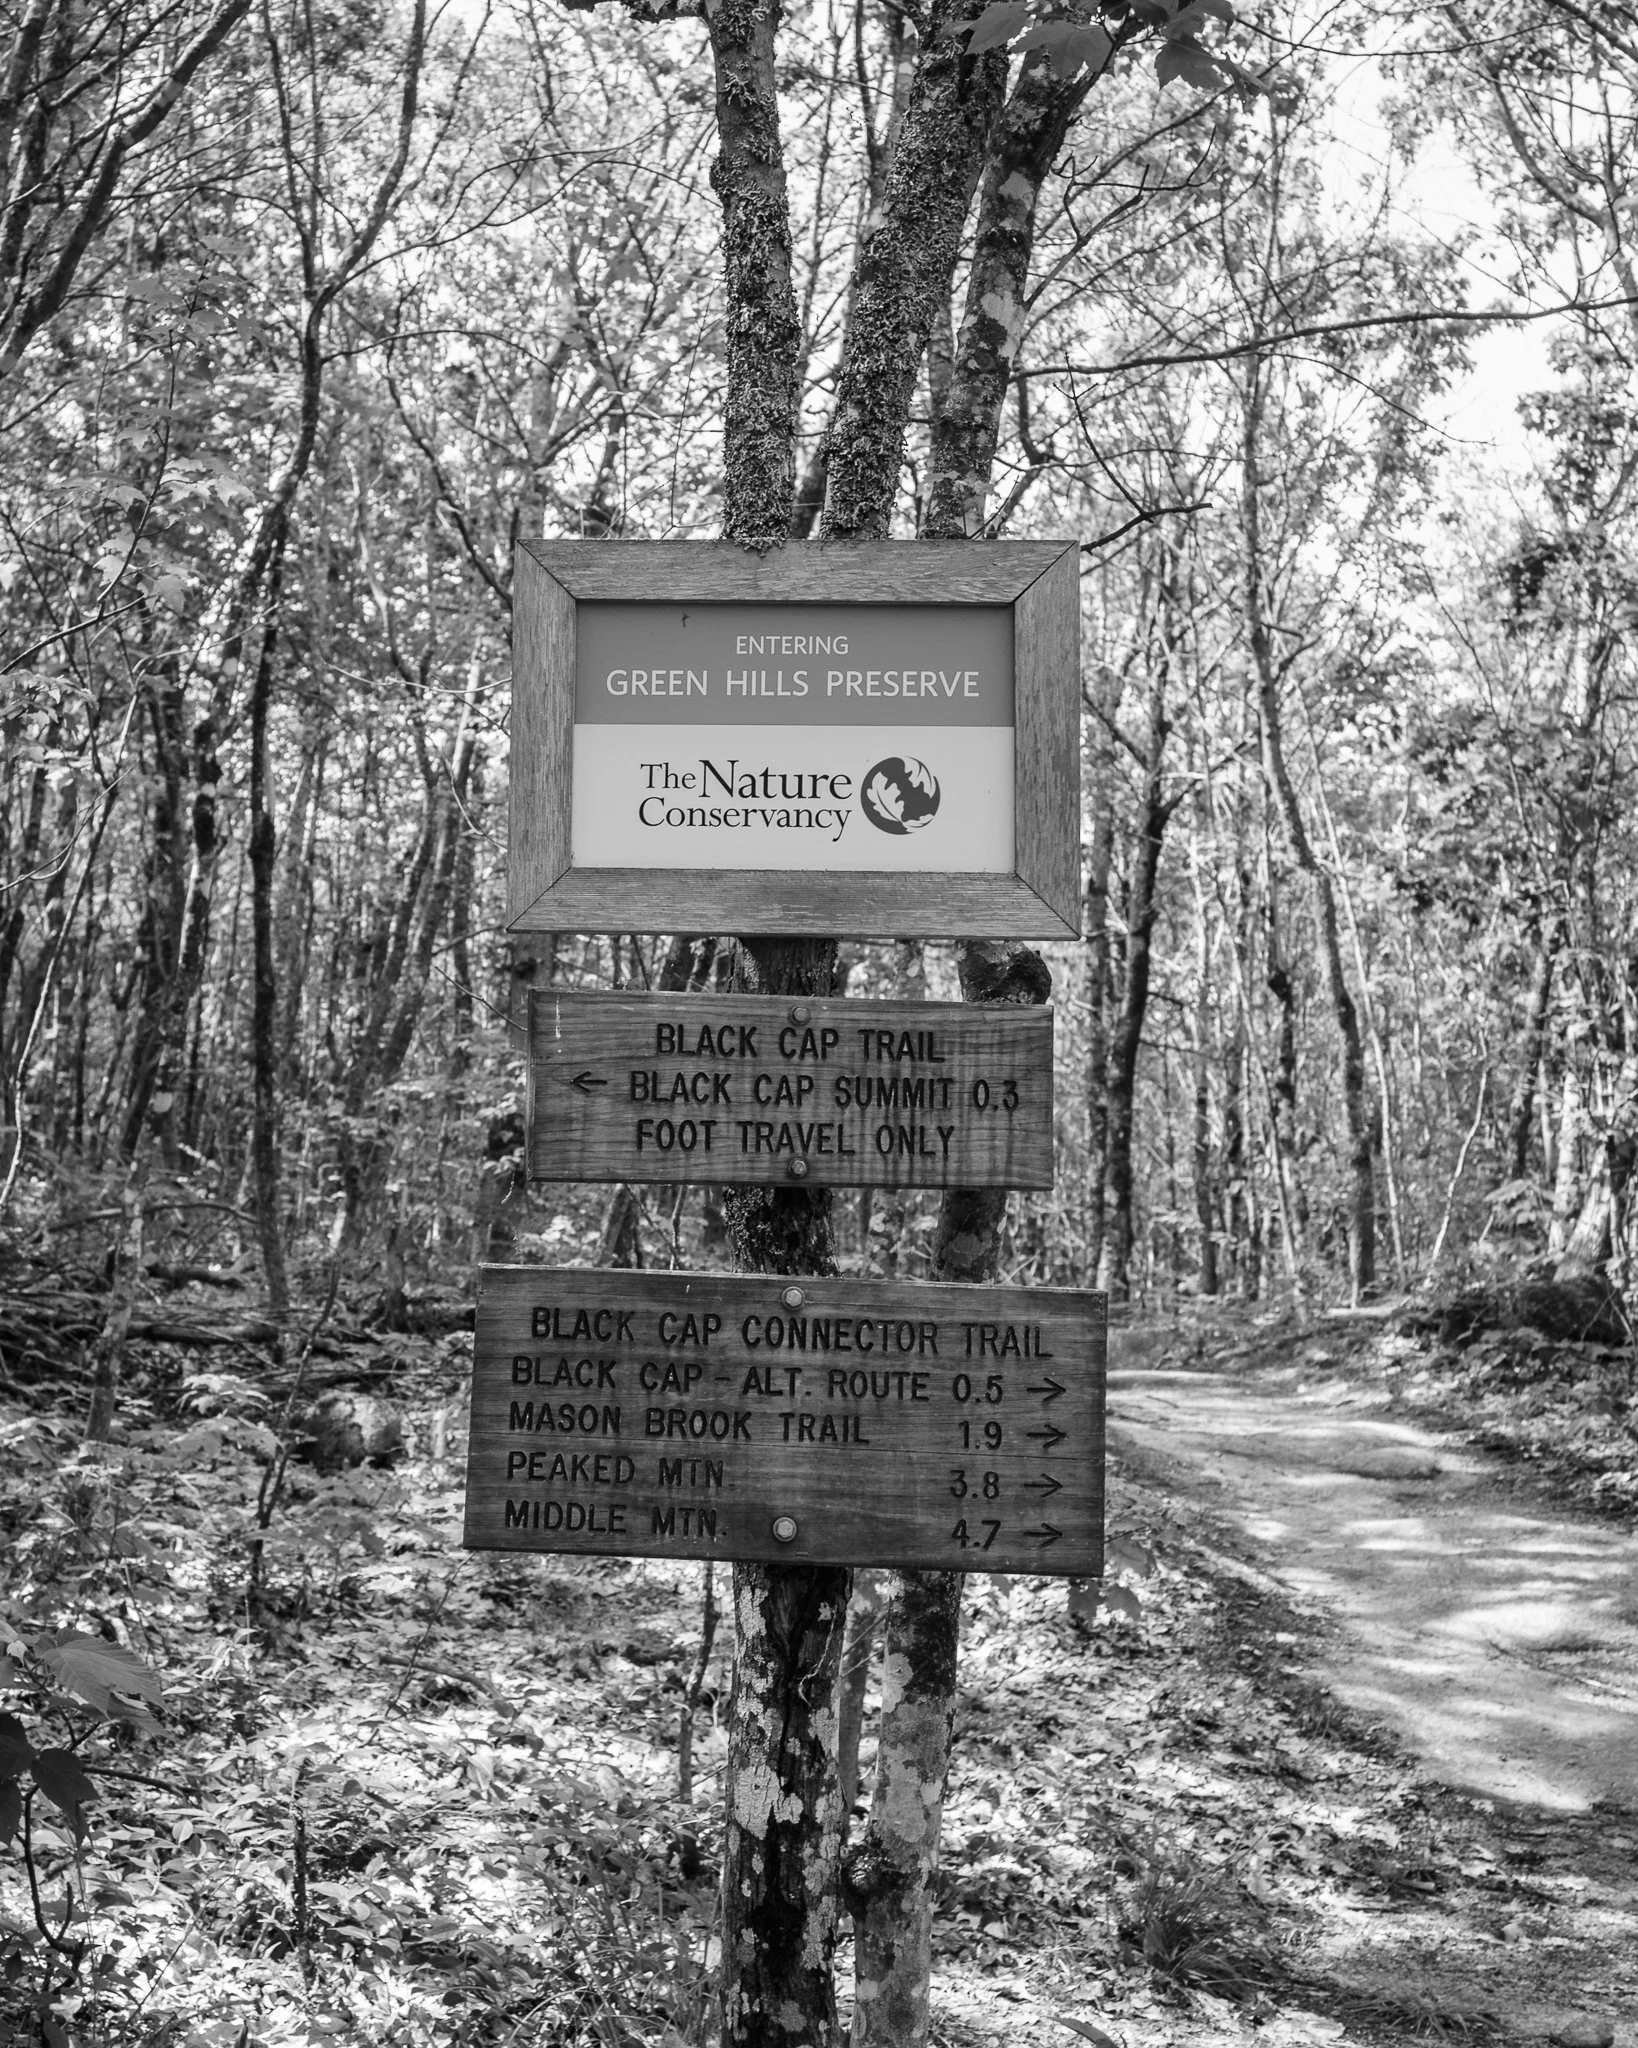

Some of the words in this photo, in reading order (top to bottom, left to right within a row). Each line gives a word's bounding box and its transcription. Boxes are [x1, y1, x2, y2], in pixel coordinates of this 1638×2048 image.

[736, 636, 849, 655] ENTERING
[606, 670, 708, 696] GREEN
[726, 671, 808, 697] HILLS
[827, 671, 980, 698] PRESERVE
[641, 763, 696, 789] The
[699, 760, 852, 800] Nature
[639, 797, 852, 842] Conservancy
[656, 1024, 757, 1058] BLACK
[779, 1027, 839, 1060] CAP
[858, 1029, 945, 1063] TRAIL
[630, 1071, 731, 1103] BLACK
[753, 1074, 814, 1106] CAP
[835, 1076, 953, 1109] SUMMIT
[974, 1080, 1019, 1111] 0.3
[637, 1119, 717, 1152] FOOT
[740, 1121, 855, 1155] TRAVEL
[876, 1125, 955, 1157] ONLY
[531, 1307, 635, 1343] BLACK
[659, 1313, 721, 1346] CAP
[742, 1316, 939, 1354] CONNECTOR
[960, 1323, 1053, 1358] TRAIL
[512, 1356, 617, 1389] BLACK
[639, 1362, 703, 1392] CAP
[742, 1366, 812, 1397] ALT.
[828, 1369, 930, 1402] ROUTE
[953, 1374, 1003, 1403] 0.5
[509, 1402, 621, 1434] MASON
[645, 1408, 753, 1441] BROOK
[779, 1413, 870, 1444] TRAIL
[960, 1421, 1003, 1450] 1.9
[507, 1452, 635, 1484] PEAKED
[950, 1470, 1000, 1499] 3.8
[504, 1501, 626, 1535] MIDDLE
[951, 1520, 1000, 1549] 4.7
